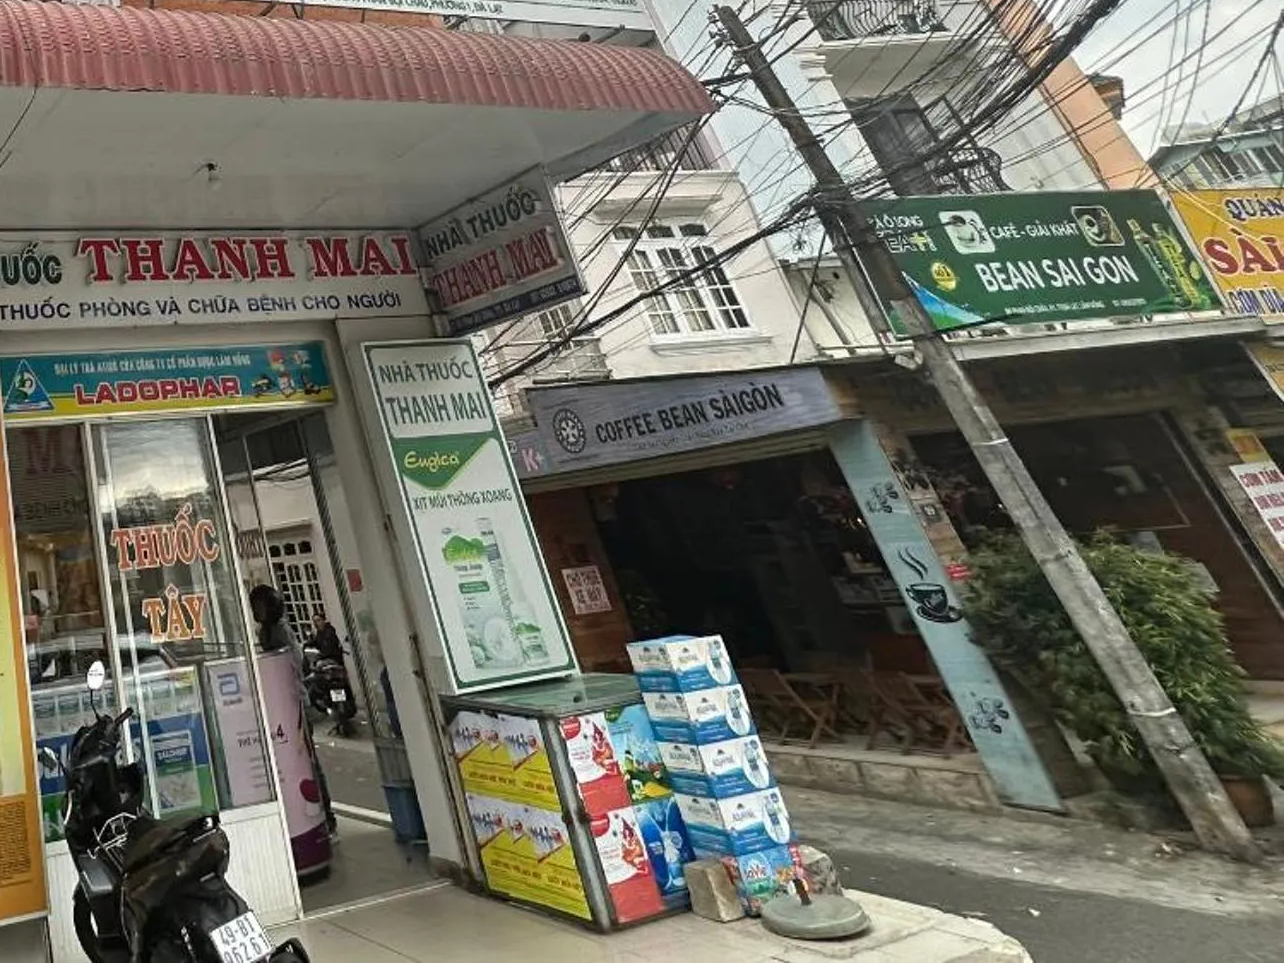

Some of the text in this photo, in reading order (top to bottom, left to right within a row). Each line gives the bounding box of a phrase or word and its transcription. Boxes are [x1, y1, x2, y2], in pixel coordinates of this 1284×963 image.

[74, 236, 295, 285] THANH
[311, 236, 417, 279] MAI
[974, 259, 1046, 293] BEAN
[1042, 257, 1086, 288] SAI
[1083, 255, 1140, 284] GON
[79, 294, 151, 319] PHÒNG
[157, 292, 183, 315] VÀ
[188, 292, 242, 316] CHỮA
[247, 290, 296, 317] BỆNH
[302, 292, 341, 311] CHO
[347, 288, 403, 310] NGƯỜI
[379, 356, 474, 386] NHÀ THUỐC
[385, 391, 488, 427] THANH MAI
[595, 412, 658, 444] COFFEE
[658, 400, 708, 433] BEAN
[404, 450, 460, 474] Eugica
[111, 503, 220, 572] THUỐC
[142, 583, 207, 643] TÂY
